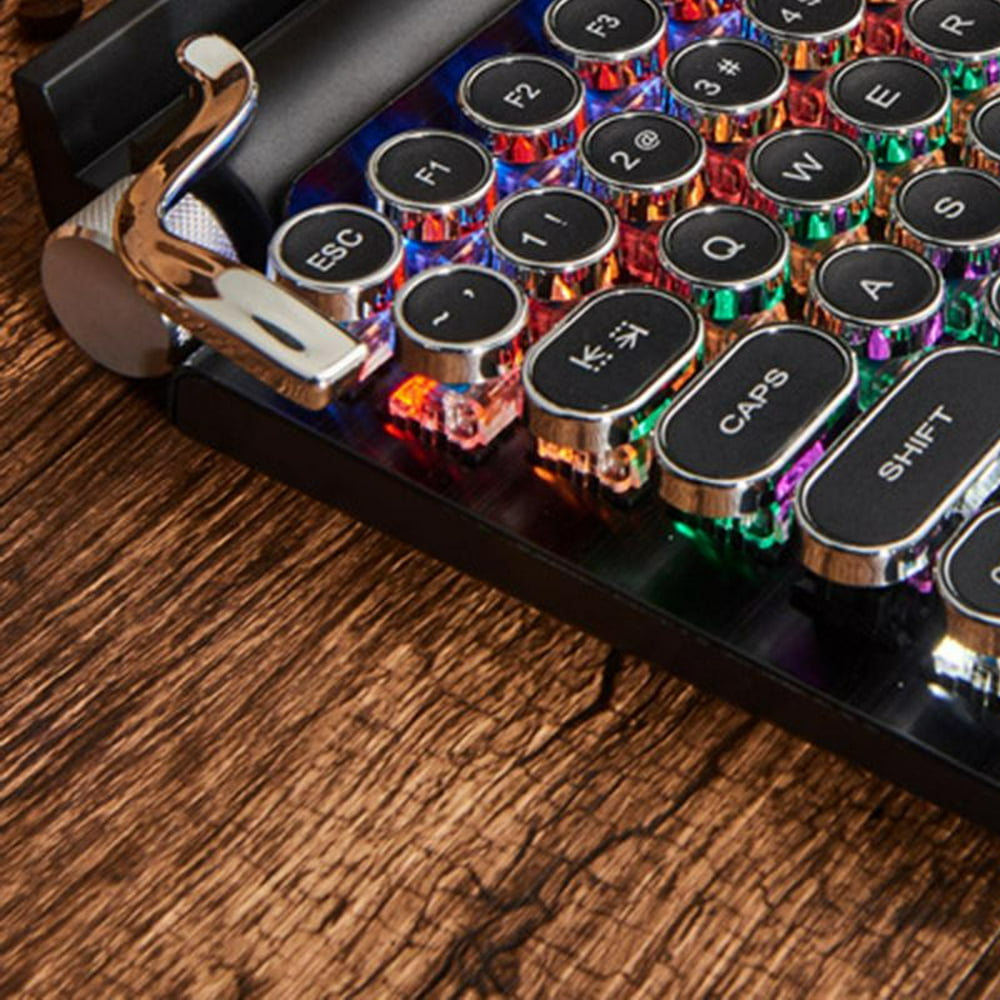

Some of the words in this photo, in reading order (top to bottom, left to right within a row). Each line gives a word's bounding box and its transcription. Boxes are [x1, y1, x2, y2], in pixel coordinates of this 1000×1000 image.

[585, 14, 620, 38] F3
[781, 8, 802, 23] 4
[939, 14, 974, 36] R
[503, 83, 541, 108] F2
[693, 79, 721, 96] 3
[865, 84, 901, 109] E
[610, 150, 642, 172] 2
[782, 151, 823, 181] W
[414, 161, 451, 186] F1
[933, 196, 965, 219] S
[306, 227, 365, 273] ESC
[522, 232, 547, 246] 1
[702, 235, 746, 261] Q
[860, 279, 894, 301] A
[718, 366, 790, 436] CAPS
[877, 404, 955, 486] SHIFT
